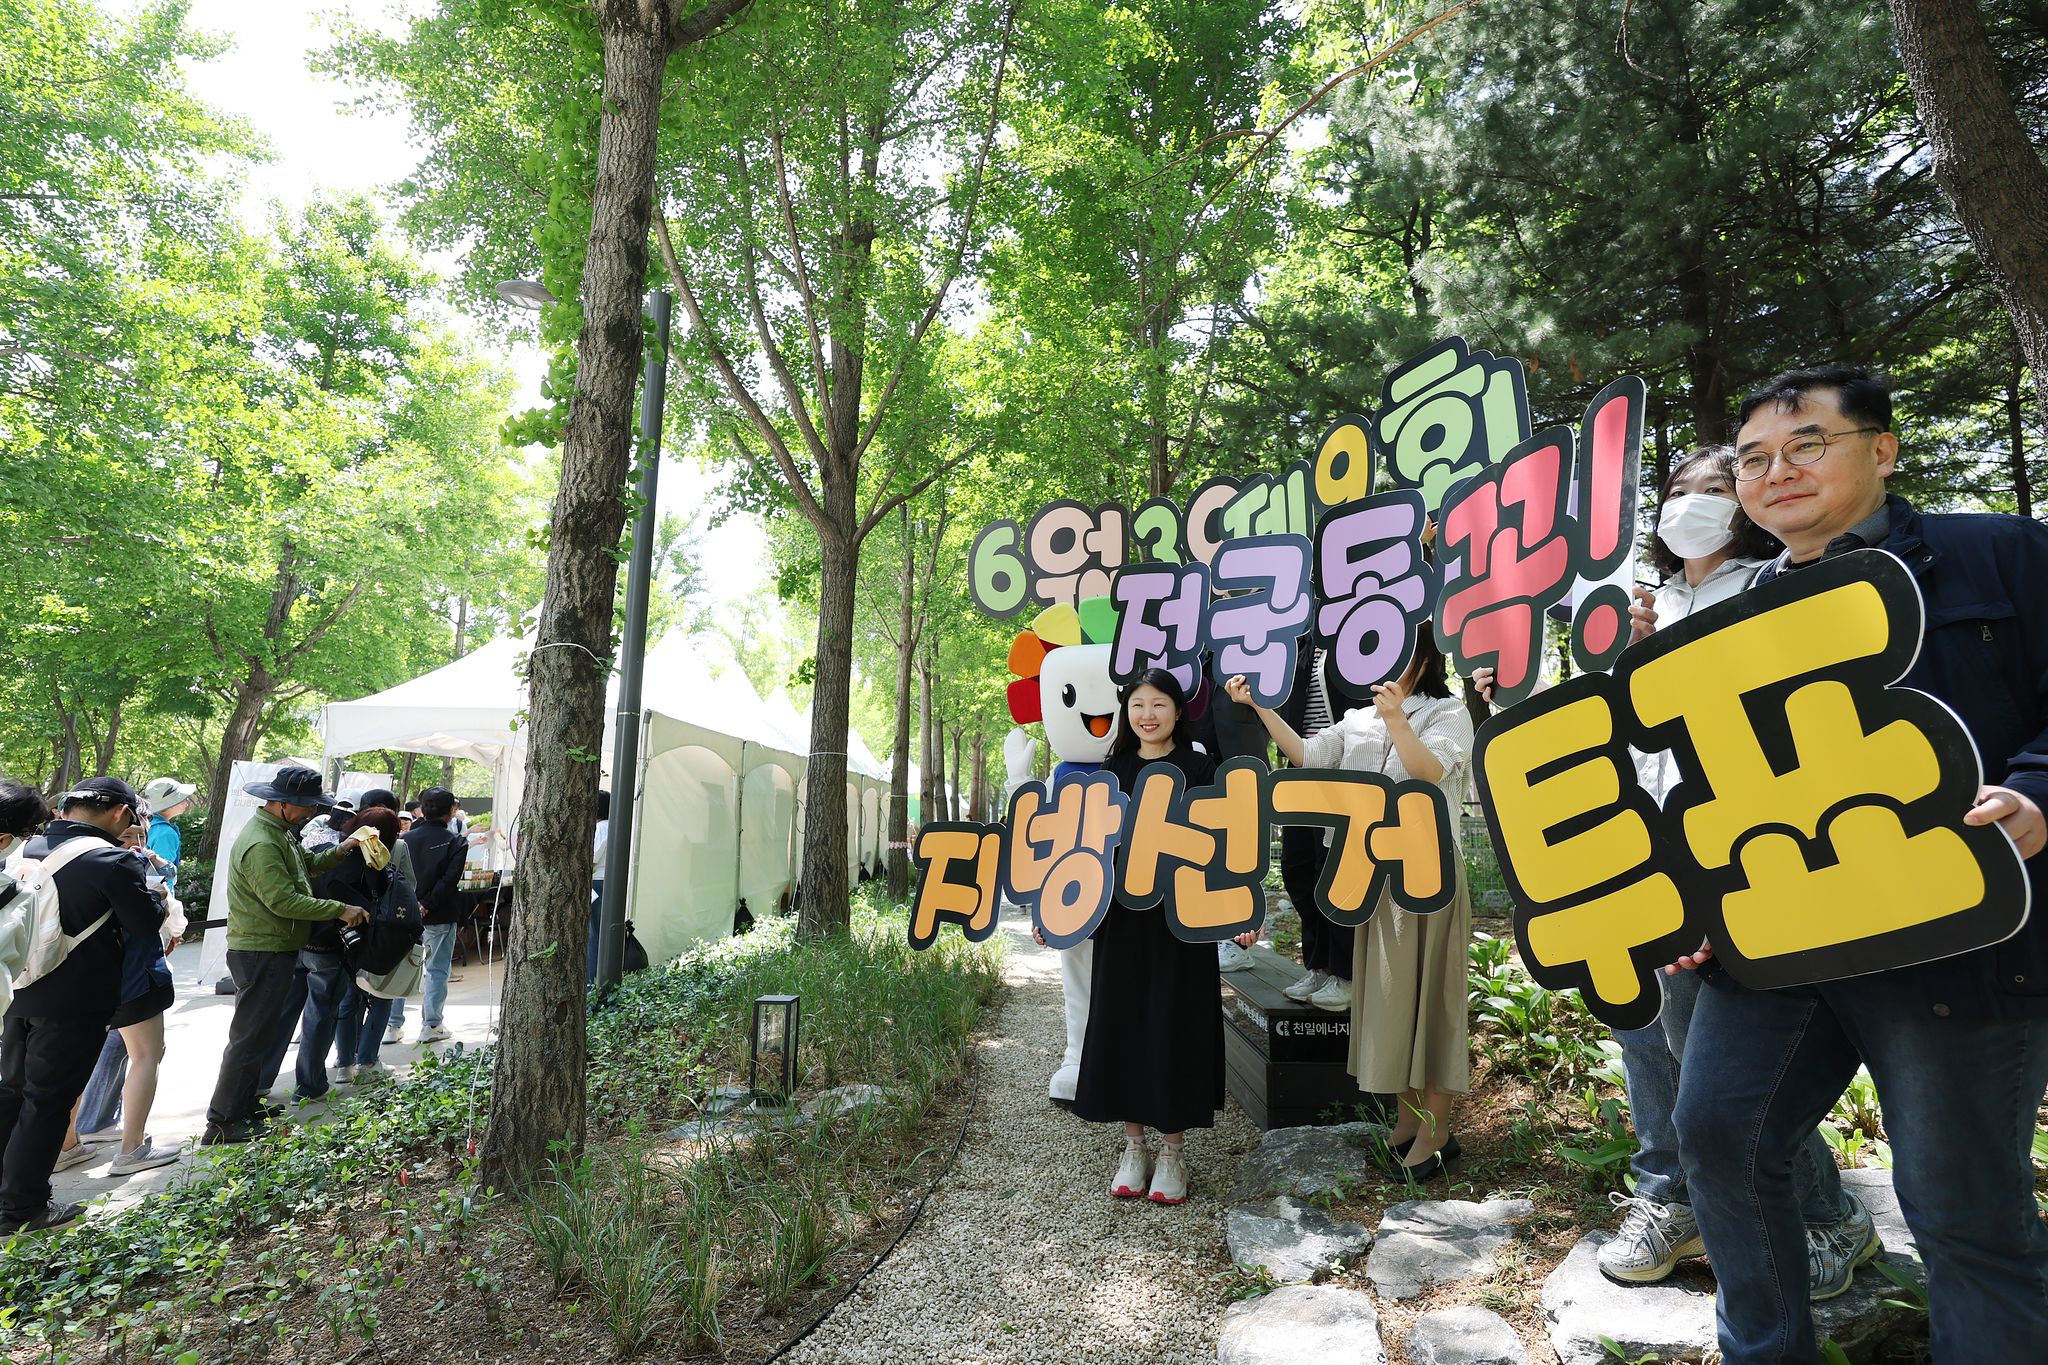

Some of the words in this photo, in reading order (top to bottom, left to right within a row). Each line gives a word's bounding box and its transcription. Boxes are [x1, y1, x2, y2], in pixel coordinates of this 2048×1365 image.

[1443, 396, 1629, 688] 꼭!
[914, 769, 1442, 939] 지방선거
[1484, 581, 1986, 1005] 투표
[1293, 1022, 1350, 1036] 천일에너지
